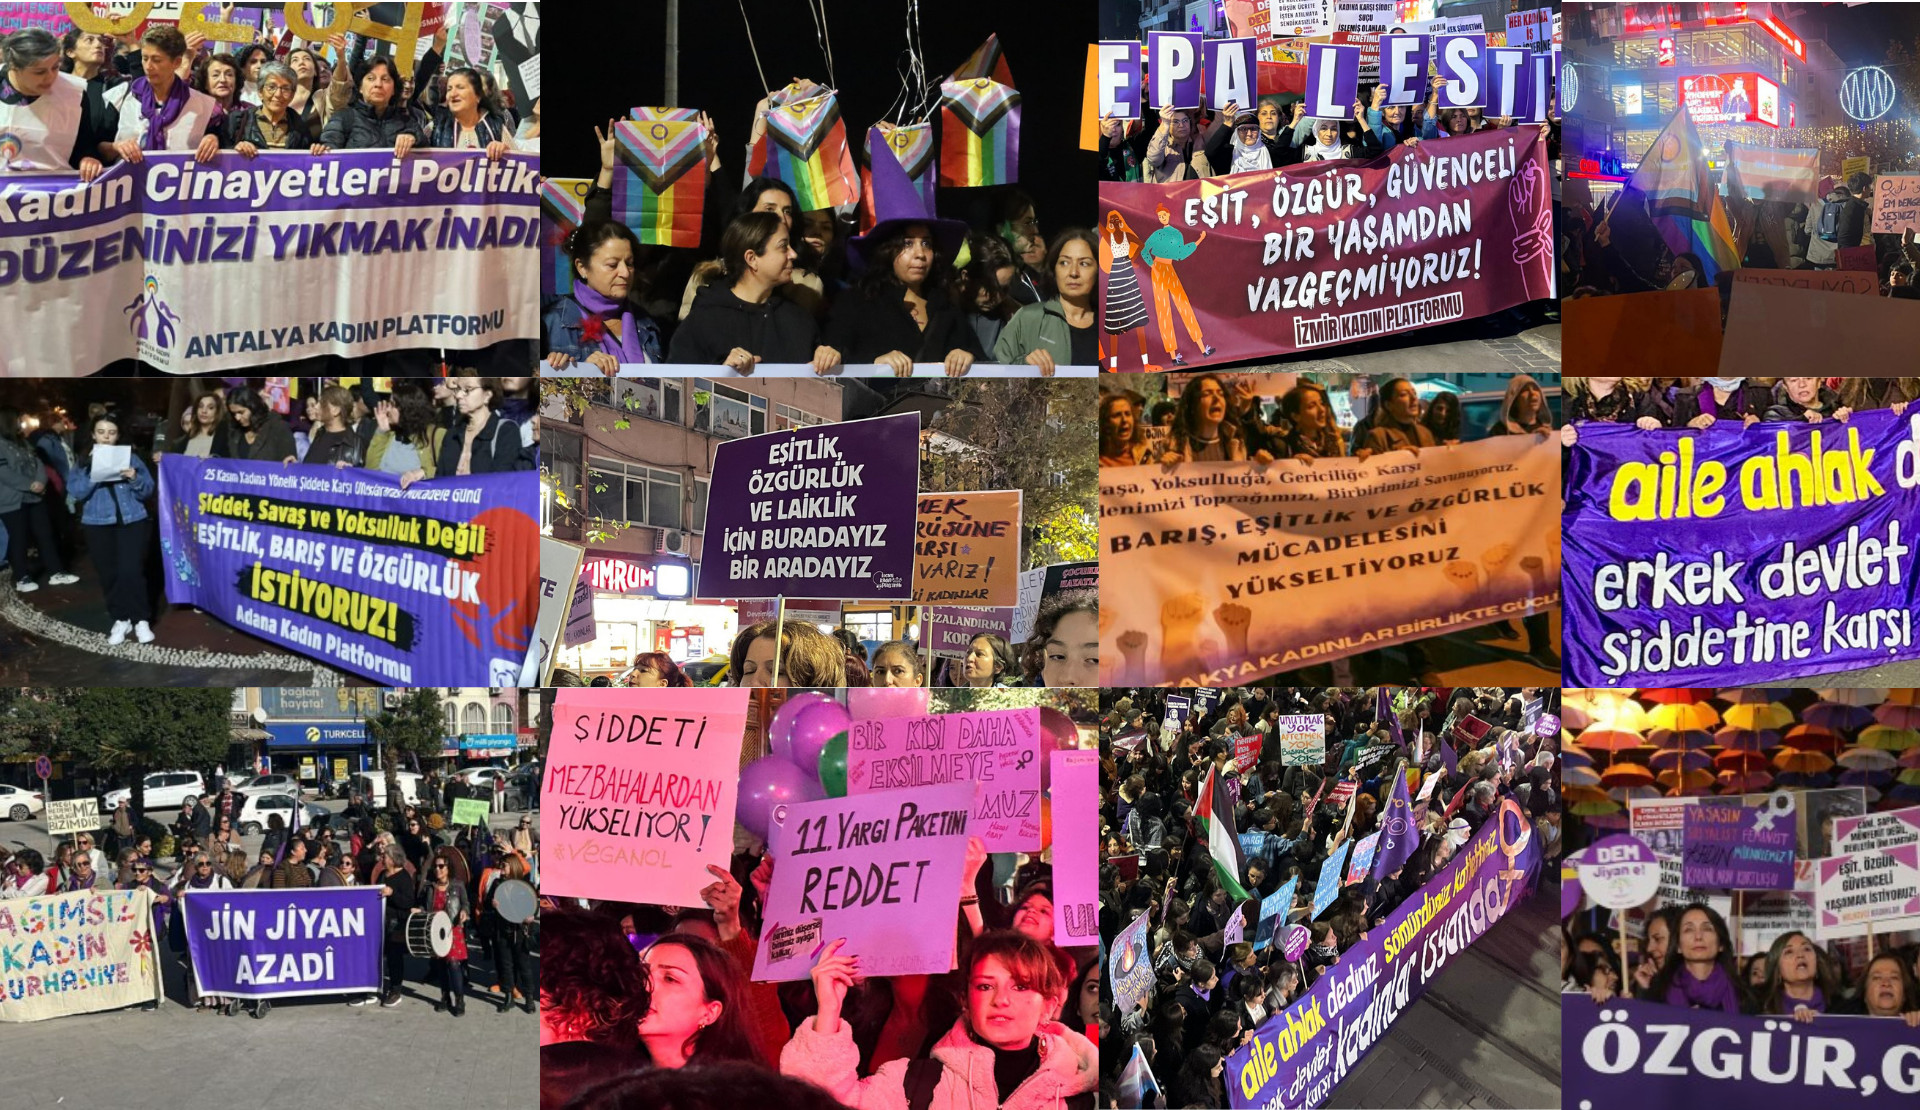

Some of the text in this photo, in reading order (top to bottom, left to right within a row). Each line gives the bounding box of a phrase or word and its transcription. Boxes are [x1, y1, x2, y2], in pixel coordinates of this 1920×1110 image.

[1509, 15, 1522, 28] HER
[146, 159, 400, 207] Cinayetleri
[409, 159, 540, 194] Politik
[1184, 139, 1517, 230] EŞİT, ÖZGÜR, GÜVENCELİ
[268, 217, 432, 260] YIKMAK
[436, 208, 540, 250] İNADI
[1262, 199, 1472, 266] BİR YAŞAMDAN
[1247, 239, 1482, 312] VAZGEÇMİYORUZ!
[185, 309, 504, 358] ANTALYA KADIN PLATFORMU
[1296, 293, 1463, 346] İZMİR KADIN PLATFORMU
[768, 433, 843, 466] EŞİTLİK,
[204, 468, 216, 480] 25
[748, 461, 864, 494] ÖZGÜRLÜK
[1151, 473, 1272, 491] Yoksulluğa,
[1279, 468, 1368, 484] Gericiliğe
[1375, 461, 1421, 476] Karşı
[1328, 477, 1419, 500] Birbirimizi
[1424, 463, 1519, 487] Savunuyoruz.
[1609, 436, 1726, 522] aile
[1740, 427, 1886, 511] ahlak
[198, 493, 485, 555] Şiddet, Savaş ve Yoksulluk Değil
[750, 491, 857, 522] VE LAİKLİK
[1110, 482, 1545, 554] BARIŞ, EŞİTLİK VE ÖZGÜRLÜK
[198, 522, 480, 605] EŞİTLİK, BARIŞ VE ÖZGÜRLÜK
[723, 524, 887, 555] İÇİN BURADAYIZ
[1237, 518, 1447, 567] MÜCADELESİNİ
[730, 554, 873, 580] BİR ARADAYIZ
[1226, 546, 1461, 599] YÜKSELTİYORUZ
[1595, 519, 1909, 612] erkek devlet
[251, 562, 398, 643] İSTİYORUZ!
[236, 604, 412, 684] Adana Kadın Platformu
[1259, 627, 1394, 669] KADINLAR
[1397, 605, 1499, 636] BİRLİKTE
[1599, 600, 1912, 685] şiddetine karşı
[280, 697, 324, 710] hayata!
[323, 730, 366, 739] TURKCELL
[574, 713, 707, 749] ŞİDDETİ
[853, 720, 886, 751] BİR
[958, 716, 1017, 749] DAHA
[548, 765, 722, 812] MEZBAHALARDAN
[869, 751, 995, 789] EKSİLMEYE
[973, 790, 1039, 820] MÜZ
[791, 815, 832, 856] 11.
[1597, 845, 1641, 863] DEM
[800, 860, 930, 914] REDDET
[205, 902, 366, 941] JİN JÎYAN
[235, 945, 335, 985] AZADÎ
[1289, 1034, 1334, 1100] devlet
[1333, 952, 1417, 1084] kadınlar
[1420, 872, 1503, 985] isyanda
[1241, 1035, 1278, 1100] aile
[1278, 995, 1326, 1062] ahlak
